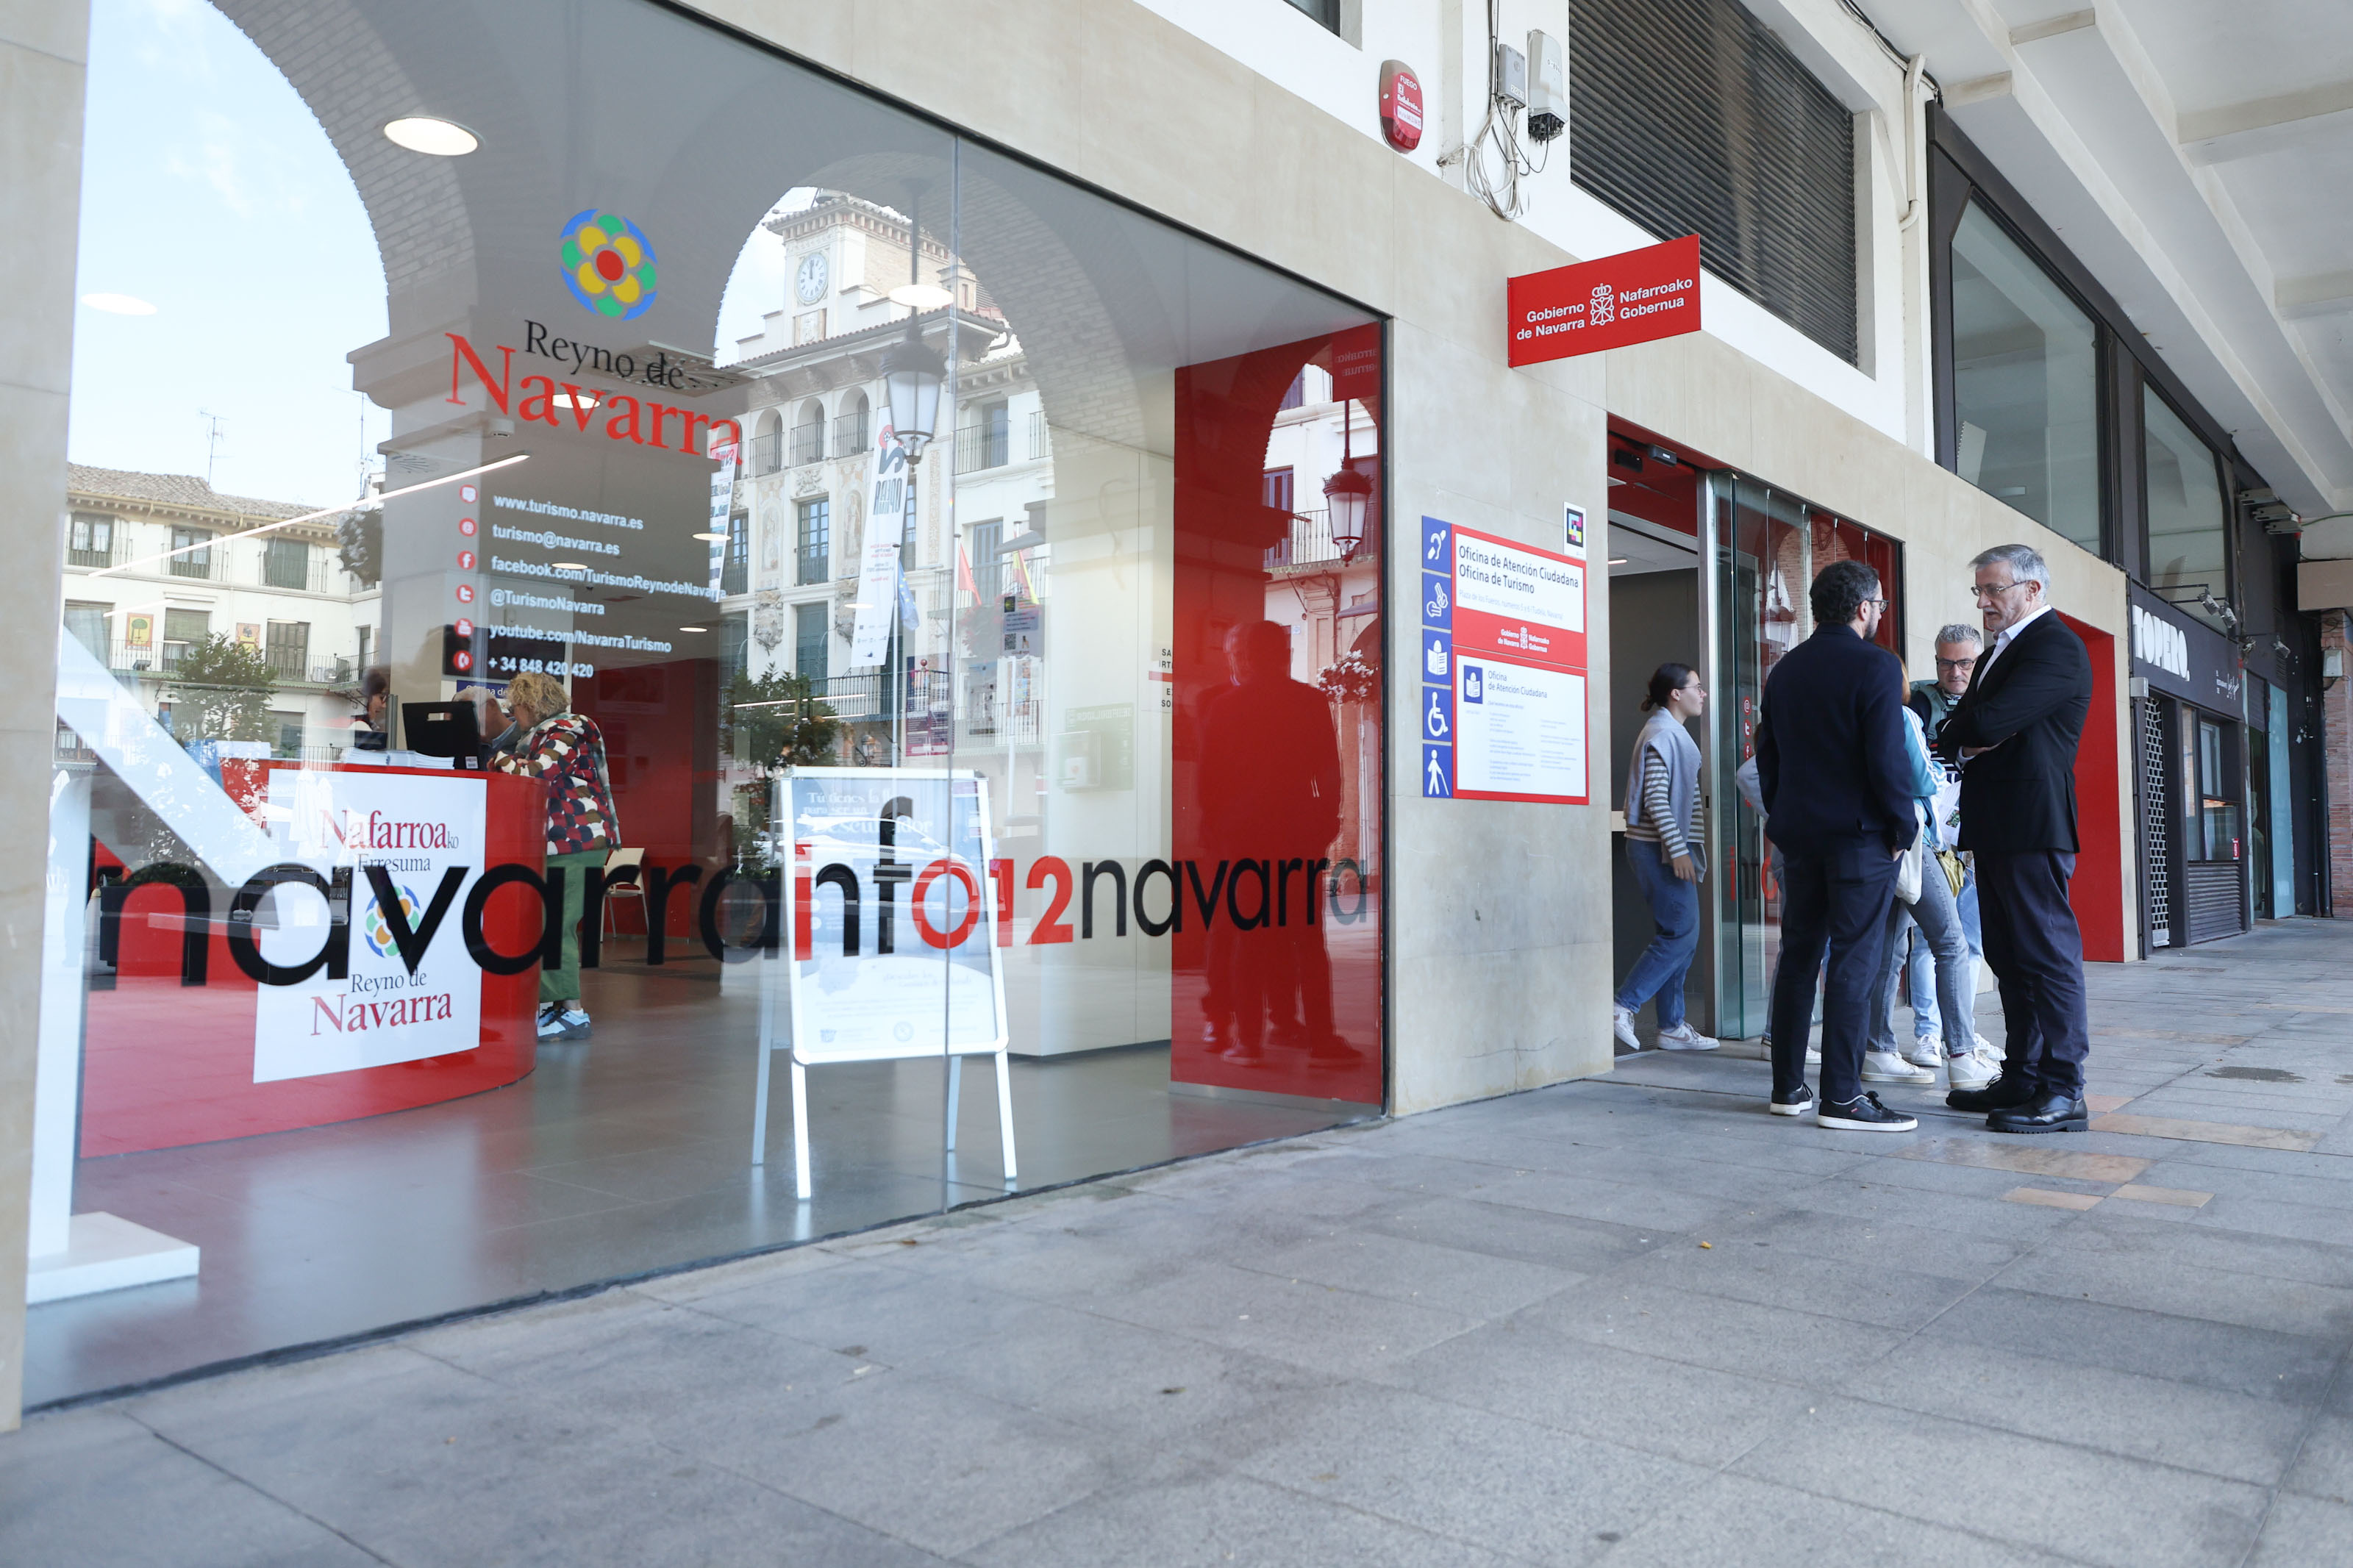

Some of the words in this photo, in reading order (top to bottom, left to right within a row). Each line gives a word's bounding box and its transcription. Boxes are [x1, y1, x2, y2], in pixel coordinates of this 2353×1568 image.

[1399, 75, 1418, 90] FUEGO
[1620, 278, 1693, 304] Nafarroako
[1527, 302, 1585, 323] Gobierno
[1620, 296, 1685, 320] Gobernua
[1516, 328, 1532, 341] de
[1535, 318, 1585, 337] Navarra
[524, 319, 635, 378] Reyno
[646, 352, 684, 390] de
[444, 332, 743, 465] Navarra
[493, 494, 644, 531] www.turismo.navarra.es
[492, 524, 621, 556] turismo@navarra.es
[490, 555, 727, 600] facebook.com/TurismoReynodeNavarra
[1459, 545, 1489, 565] Oficina
[1491, 554, 1501, 568] de
[1503, 557, 1538, 578] Atención
[1540, 567, 1579, 588] Ciudadana
[1459, 564, 1489, 583] Oficina
[1491, 573, 1502, 586] de
[1503, 575, 1535, 594] Turismo
[490, 589, 605, 616] @TurismoNavarra
[488, 623, 672, 654] youtube.com/NavarraTurismo
[1501, 629, 1519, 638] Gobierno
[1504, 638, 1519, 648] Navarra
[500, 656, 516, 672] 34
[519, 657, 543, 674] 848
[546, 660, 568, 676] 420
[571, 662, 594, 679] 420
[1488, 670, 1507, 681] Oficina
[1488, 682, 1496, 692] de
[1496, 684, 1520, 695] Atención
[1521, 687, 1548, 698] Ciudadana
[357, 853, 431, 873] Erresuma
[351, 973, 404, 998] Reyno
[409, 968, 428, 987] de
[310, 992, 452, 1037] Navarra
